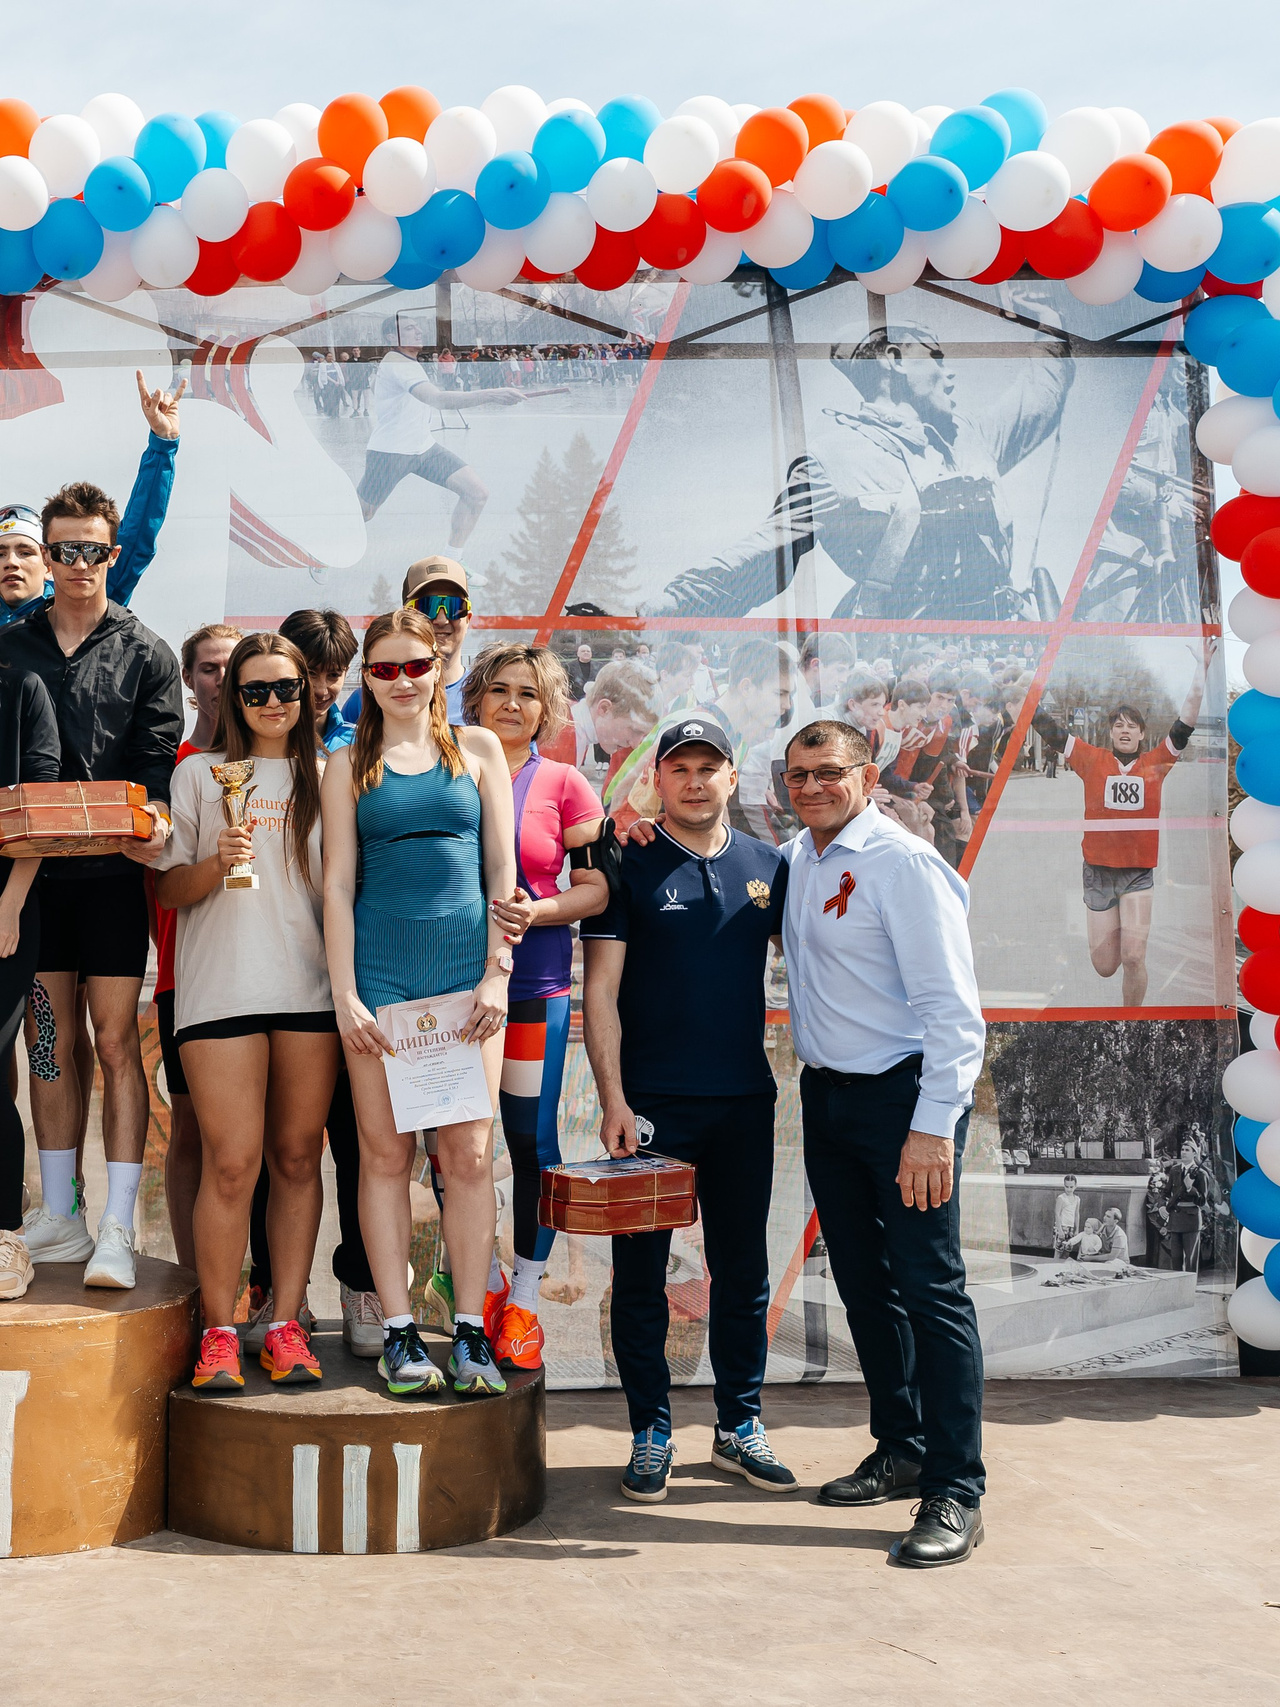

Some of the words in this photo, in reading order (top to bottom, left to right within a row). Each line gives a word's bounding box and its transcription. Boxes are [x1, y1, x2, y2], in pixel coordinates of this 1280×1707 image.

[1111, 782, 1140, 804] 188
[246, 798, 296, 812] aturd
[243, 811, 296, 832] hoppi
[395, 1028, 464, 1053] ДИПЛОМ
